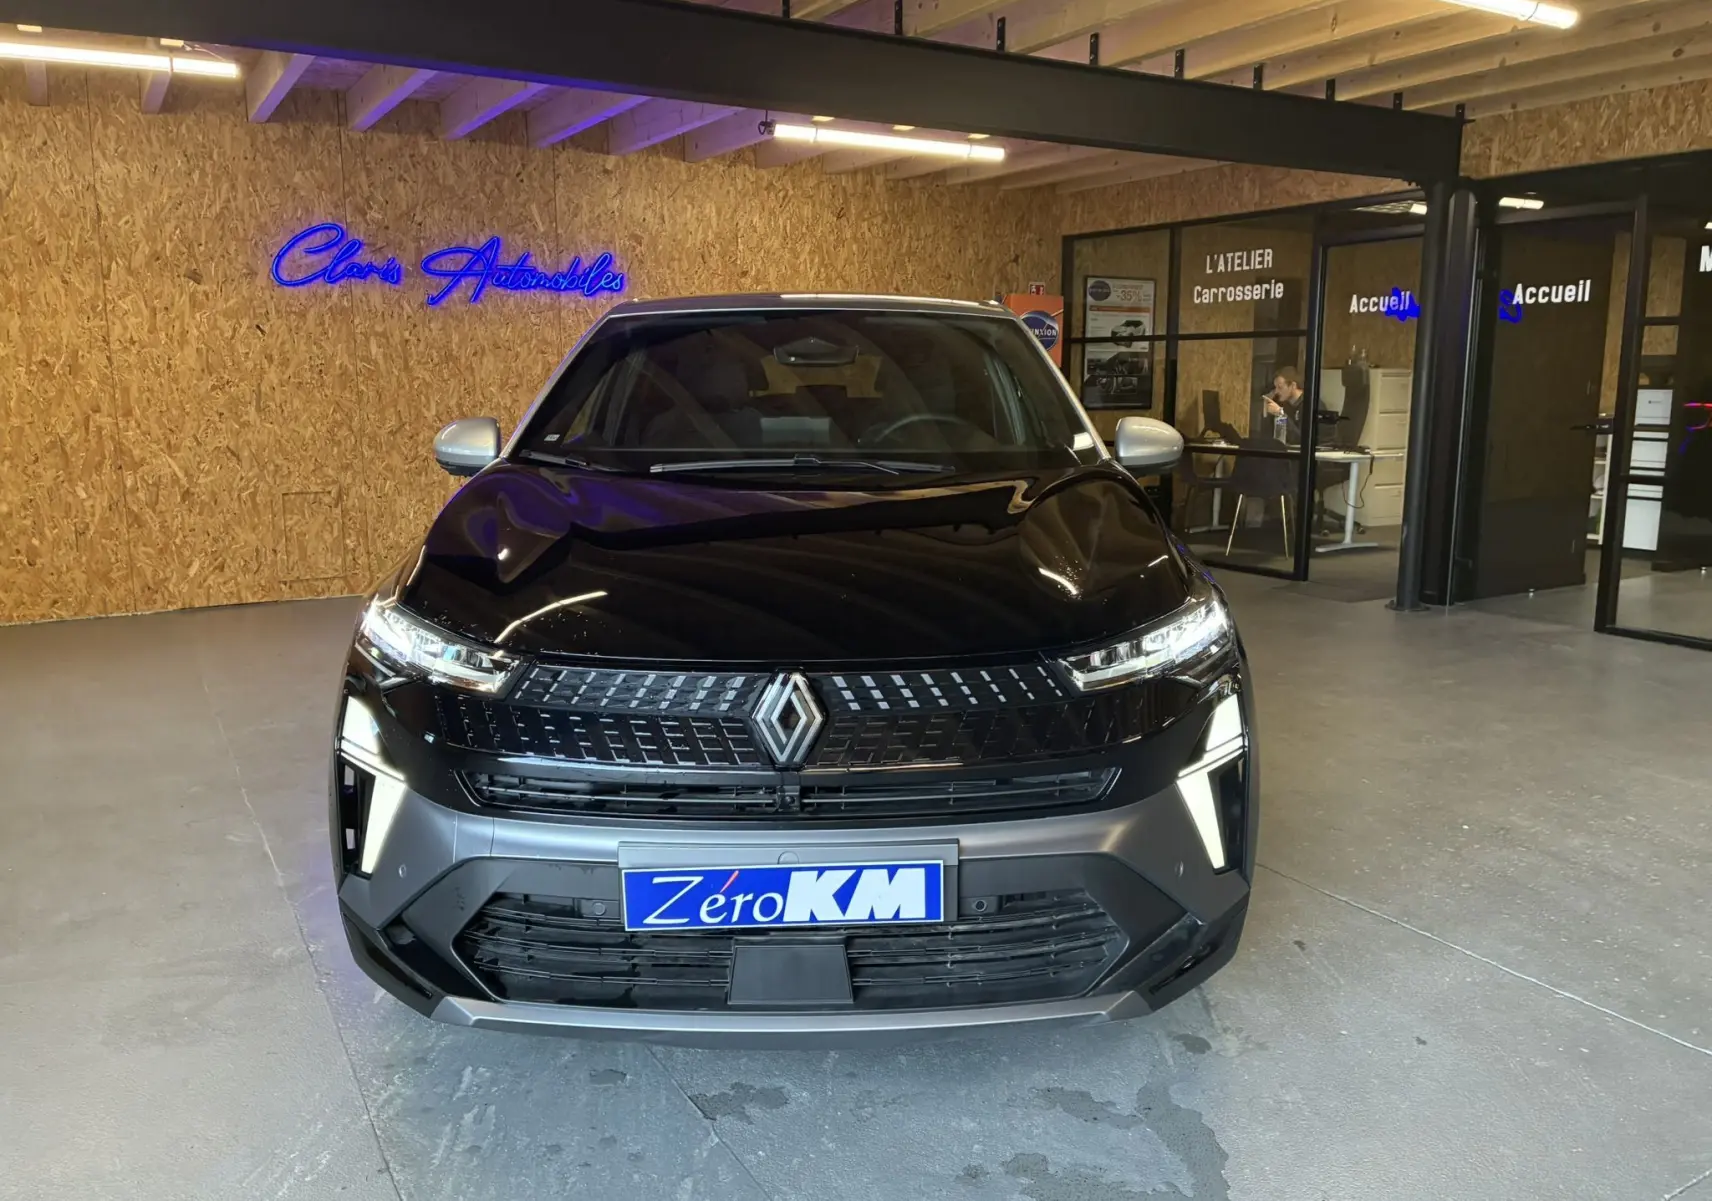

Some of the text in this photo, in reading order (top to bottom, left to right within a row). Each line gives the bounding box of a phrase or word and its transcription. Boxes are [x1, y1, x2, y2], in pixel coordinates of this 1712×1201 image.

[272, 222, 625, 306] Claris Automobiles
[1205, 248, 1273, 274] L'ATELIER
[1193, 279, 1284, 304] Carrosserie
[1349, 291, 1411, 313] Accueil
[1512, 279, 1592, 305] Accueil
